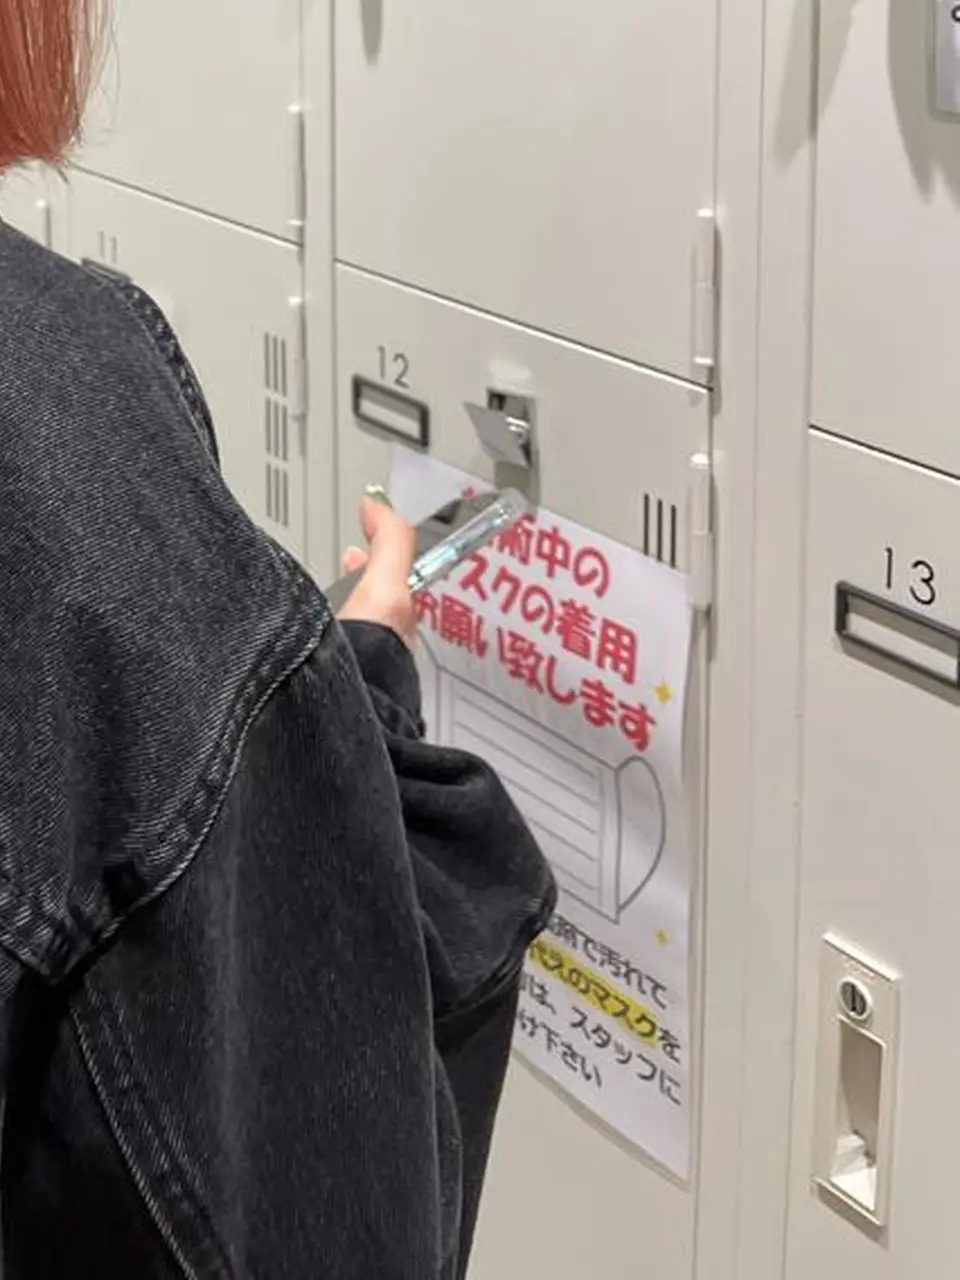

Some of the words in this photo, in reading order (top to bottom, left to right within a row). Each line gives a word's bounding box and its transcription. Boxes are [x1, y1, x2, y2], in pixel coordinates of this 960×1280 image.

[376, 345, 411, 389] 12
[487, 513, 610, 598] 術中の
[884, 546, 937, 606] 13
[445, 551, 638, 684] スクの着用
